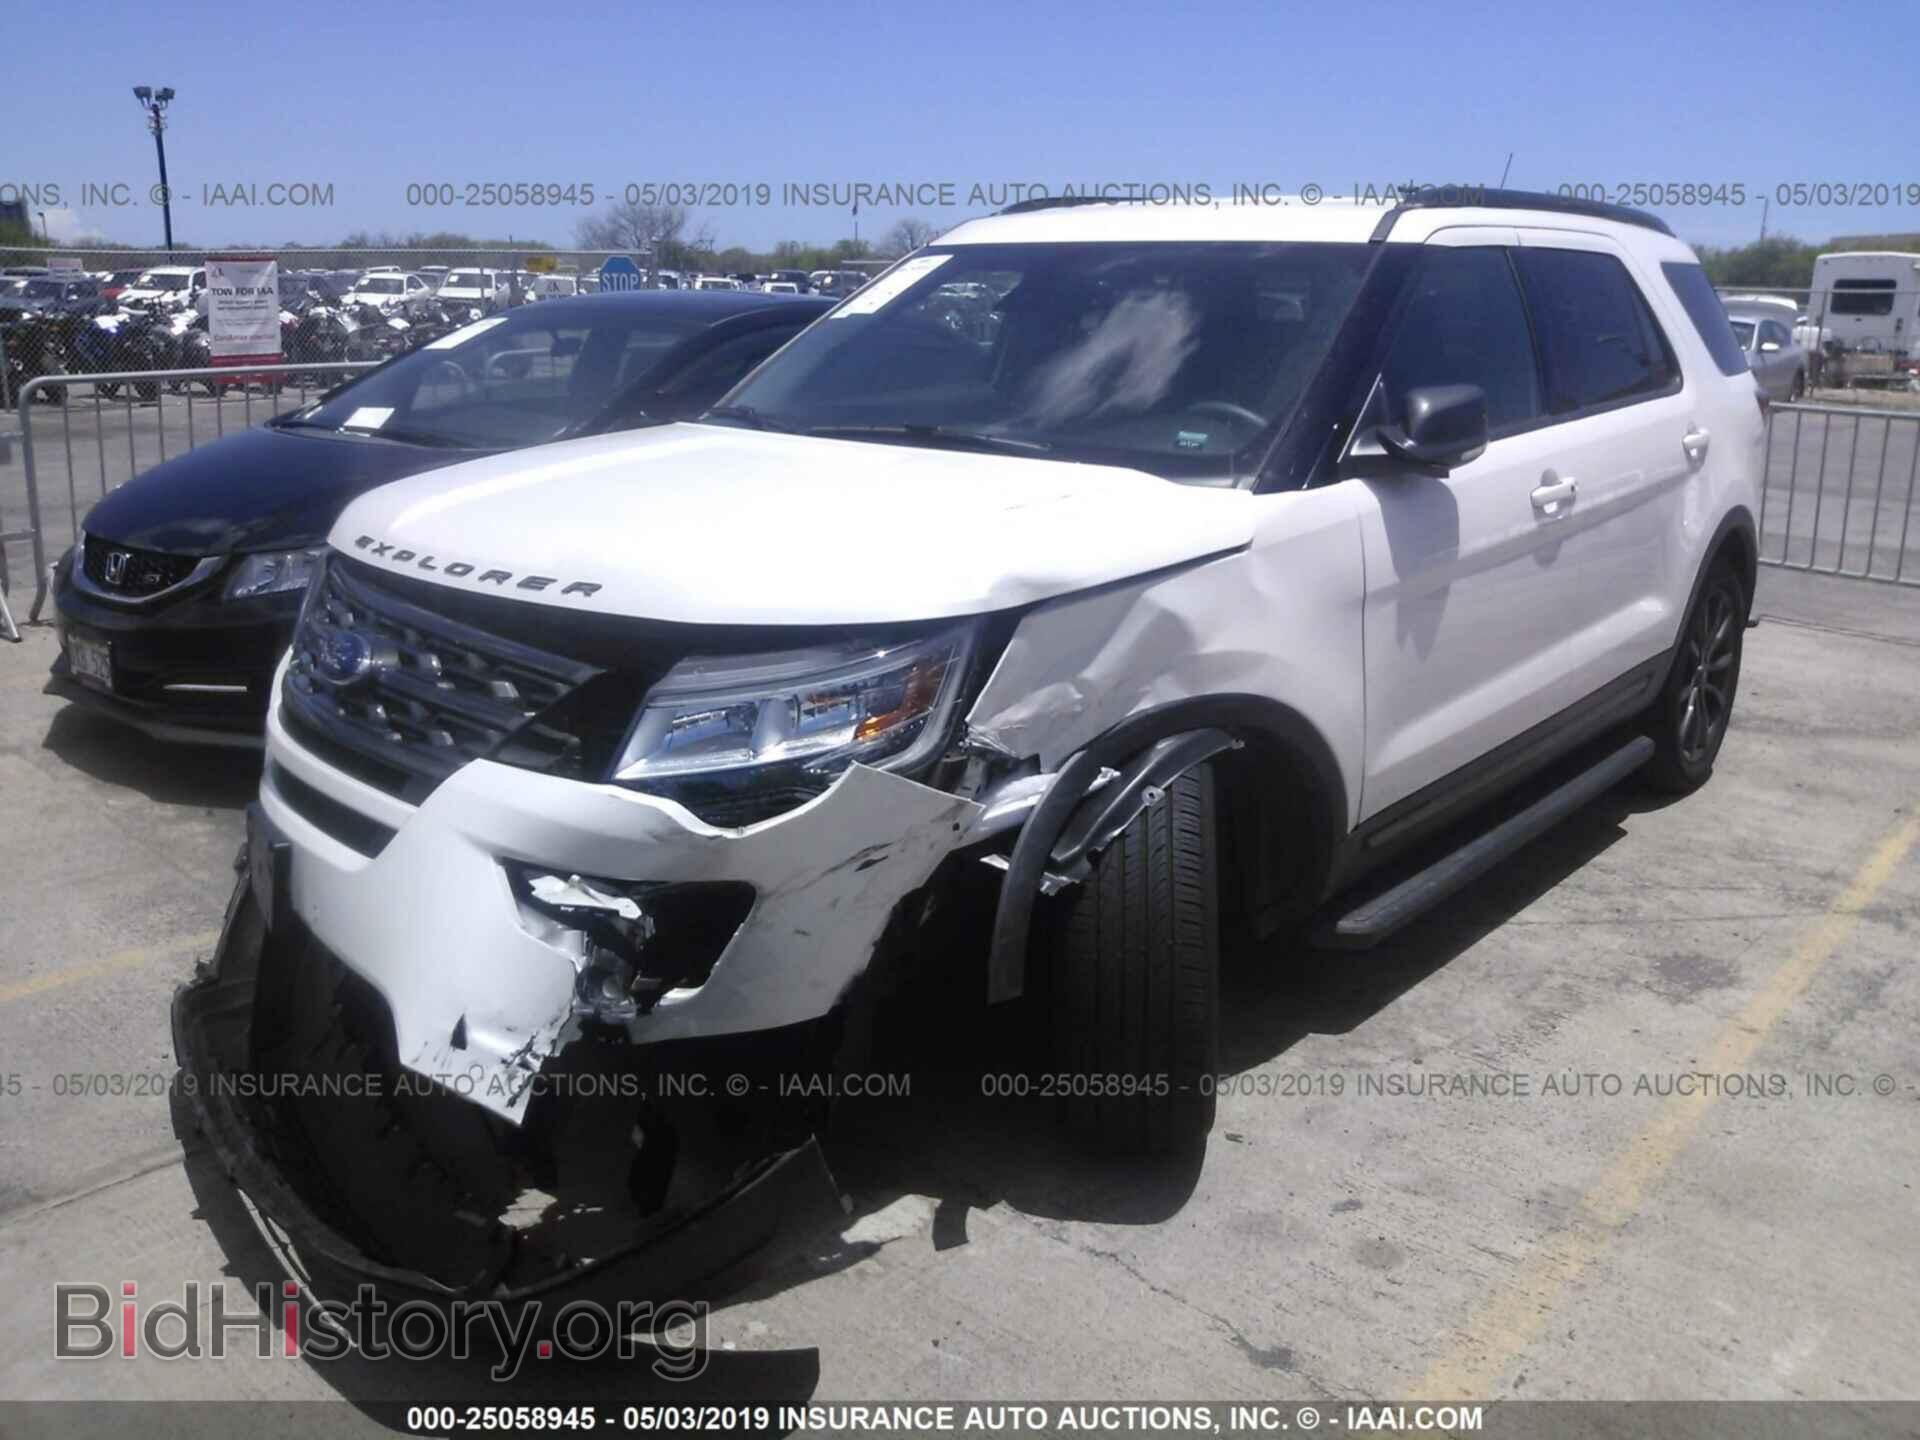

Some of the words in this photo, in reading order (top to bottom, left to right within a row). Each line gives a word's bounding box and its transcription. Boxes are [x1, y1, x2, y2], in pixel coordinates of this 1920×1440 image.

[211, 287, 233, 296] TOW
[236, 287, 255, 296] FOR
[602, 273, 639, 292] STOP
[355, 535, 602, 597] EXPLORER
